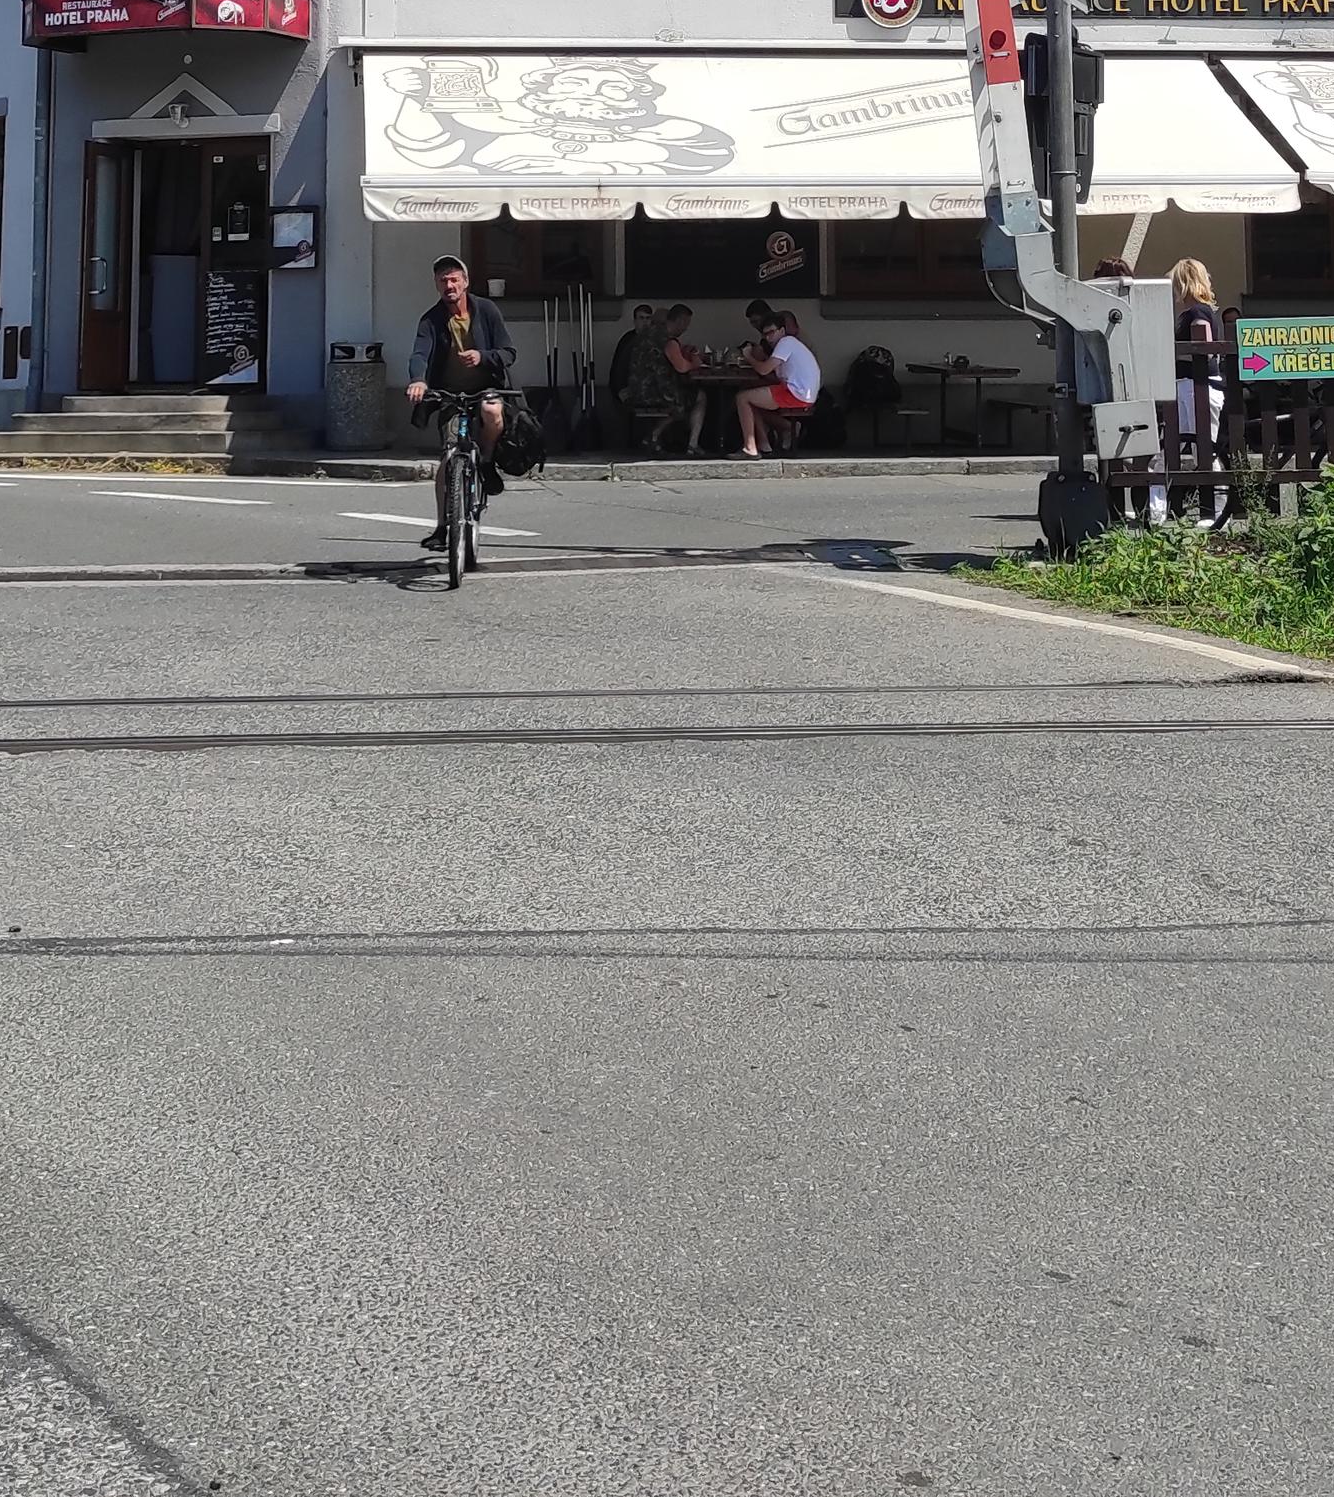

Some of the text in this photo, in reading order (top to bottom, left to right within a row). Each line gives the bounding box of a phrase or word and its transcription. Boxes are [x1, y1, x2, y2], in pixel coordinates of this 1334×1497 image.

[62, 0, 112, 10] RESTAURACE
[45, 7, 129, 26] HOTEL PRAHA
[776, 88, 973, 136] Gambrinus
[393, 195, 479, 215] Gambrinus
[520, 197, 567, 210] HOTEL
[571, 197, 621, 210] PRAHA
[666, 193, 750, 212] Gambrinus
[788, 195, 835, 209] HOTEL
[838, 195, 888, 209] PRAHA
[929, 192, 983, 212] Gambr
